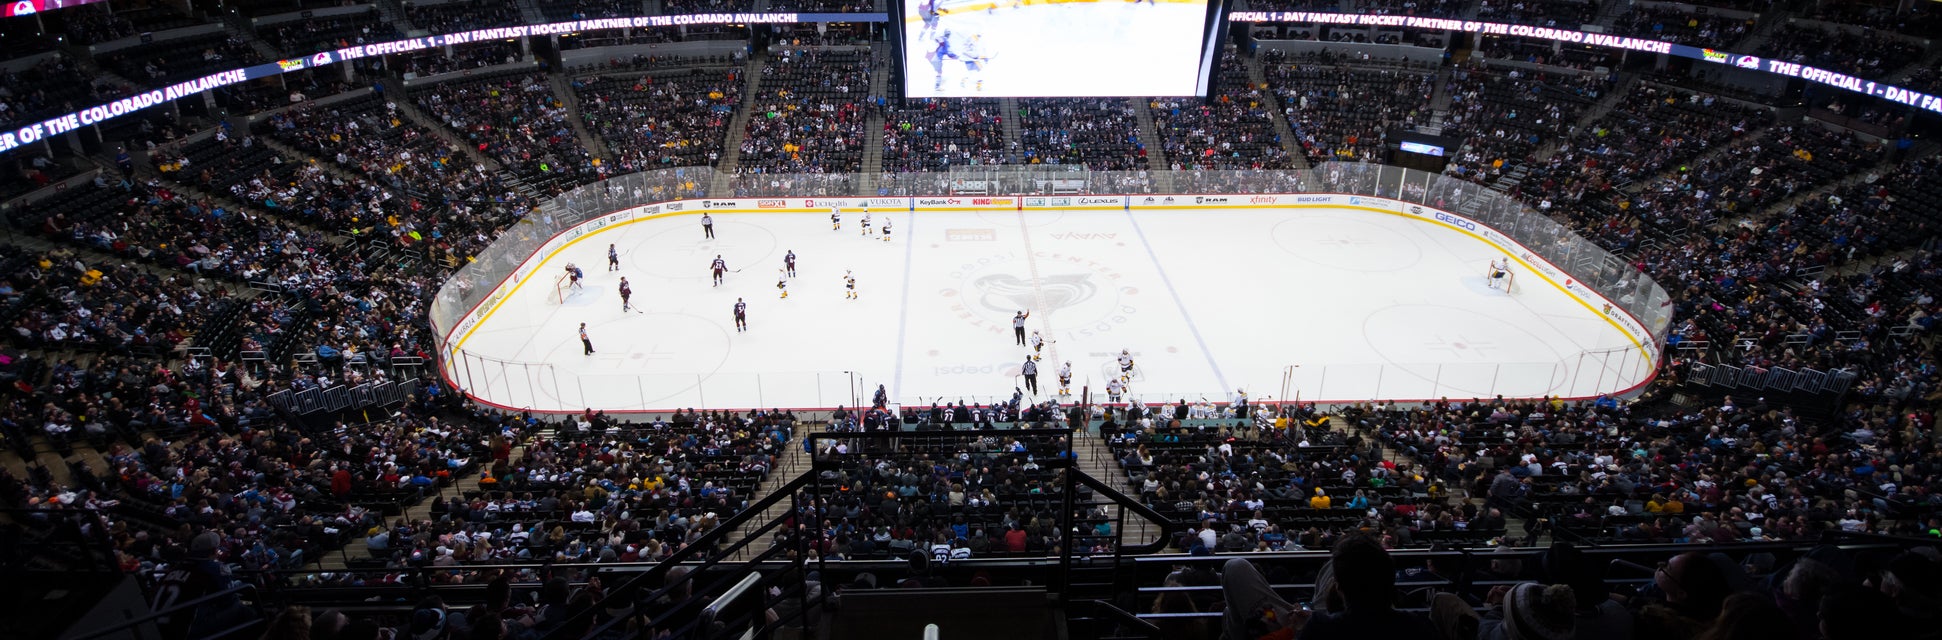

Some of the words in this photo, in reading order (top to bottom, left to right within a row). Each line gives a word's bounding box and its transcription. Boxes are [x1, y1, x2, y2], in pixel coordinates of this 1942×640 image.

[338, 47, 364, 60] THE
[366, 38, 426, 55] OFFICIAL
[428, 37, 436, 48] 1
[445, 32, 471, 45] DAY
[472, 26, 529, 41] FANTASY
[530, 21, 578, 35] HOCKEY
[580, 18, 632, 31] PARTNER
[633, 17, 649, 27] OF
[650, 16, 672, 26] THE
[673, 13, 733, 25] COLORADO
[735, 13, 798, 23] AVALANCHE
[1270, 12, 1277, 22] 1
[1283, 12, 1306, 22] DAY
[1307, 12, 1358, 24] FANTASY
[1359, 14, 1406, 26] HOCKEY
[1406, 16, 1462, 31] PARTNER
[1464, 21, 1482, 32] OF
[1483, 22, 1508, 34] THE
[1510, 25, 1582, 42] COLORADO
[1583, 33, 1672, 54] AVALANCHE
[1769, 60, 1799, 76] THE
[1801, 66, 1863, 92] OFFICIAL
[1866, 82, 1876, 95] 1
[1885, 86, 1921, 105] DAY
[19, 124, 43, 144] OF
[44, 113, 80, 136] THE
[80, 90, 163, 126] COLORADO
[166, 69, 246, 101] AVALANCHE
[1250, 196, 1277, 204] xfinity
[1435, 212, 1475, 231] GEICO
[1050, 232, 1116, 240] AVAYA
[452, 318, 475, 344] CAMBRIA
[1611, 310, 1640, 336] DRAFTKINGS
[935, 364, 993, 377] pepsi
